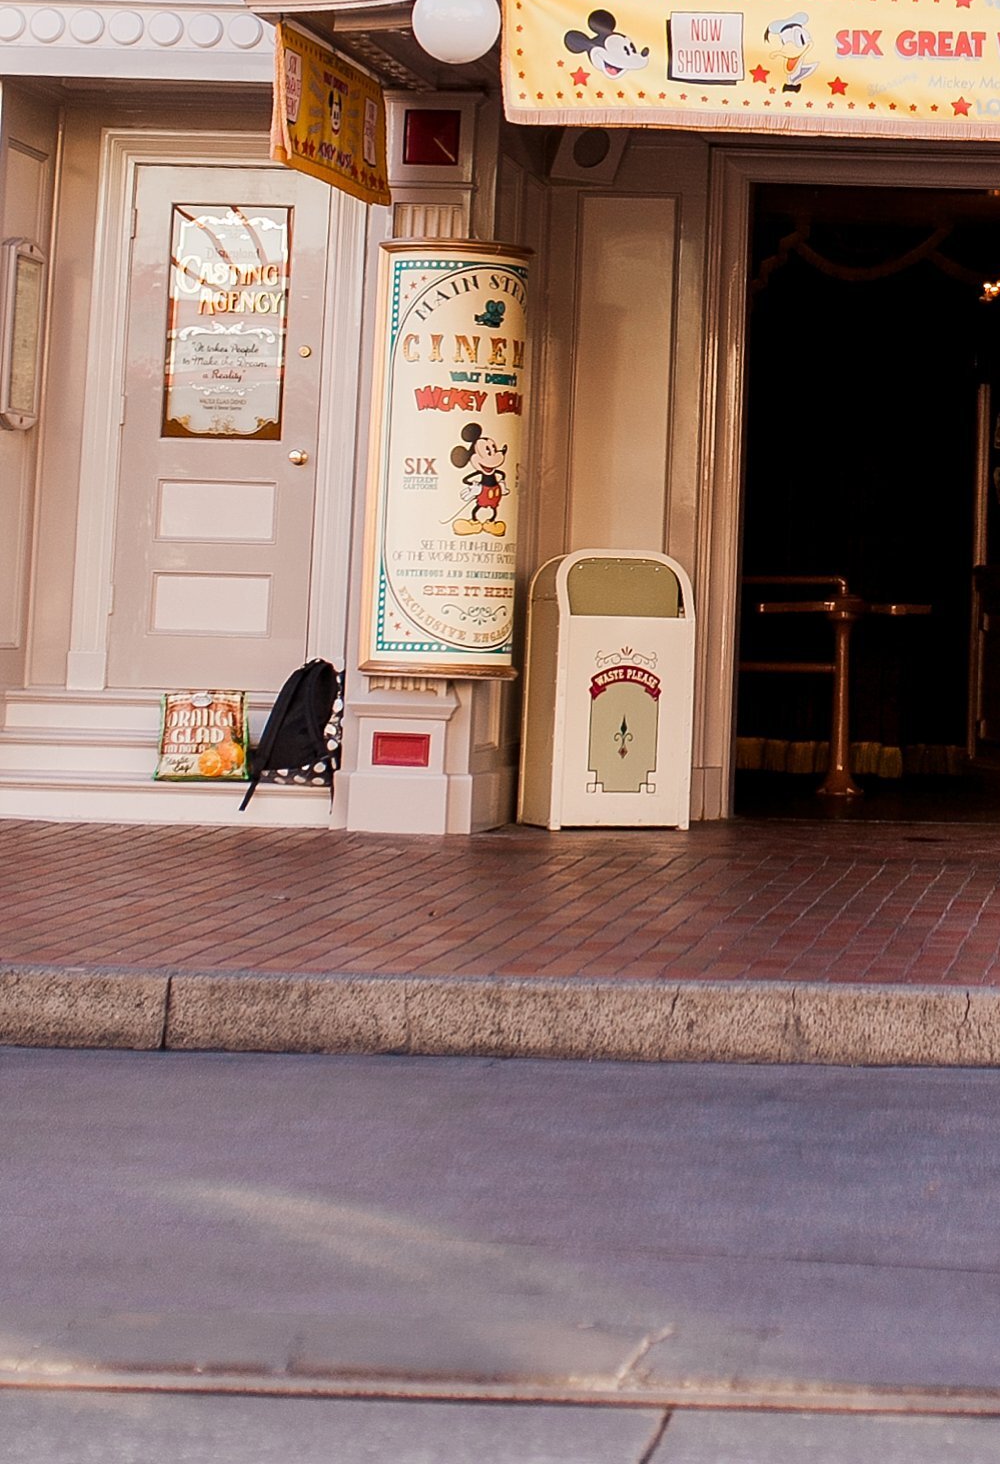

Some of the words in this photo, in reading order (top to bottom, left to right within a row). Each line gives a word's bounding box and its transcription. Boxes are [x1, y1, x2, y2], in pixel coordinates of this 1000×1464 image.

[690, 18, 722, 42] NOW
[836, 29, 884, 59] SIX
[896, 29, 986, 60] GREAT
[677, 49, 740, 76] SHOWING
[928, 74, 976, 90] Mickey
[198, 288, 282, 315] AGENCY
[415, 275, 480, 321] MAIN
[450, 371, 482, 383] WALT
[415, 385, 488, 412] MICKEY
[404, 457, 438, 475] SIX
[420, 540, 435, 550] SEE
[439, 540, 457, 551] THE
[392, 551, 402, 561] OF
[407, 551, 426, 561] THE
[471, 553, 495, 564] MOST
[447, 569, 462, 577] AND
[423, 584, 459, 596] SEE
[464, 586, 481, 597] IT
[399, 586, 467, 641] EXCLUSIVE
[594, 669, 625, 686] WASTE
[626, 669, 658, 689] PLEASE
[170, 727, 224, 744] GLAD
